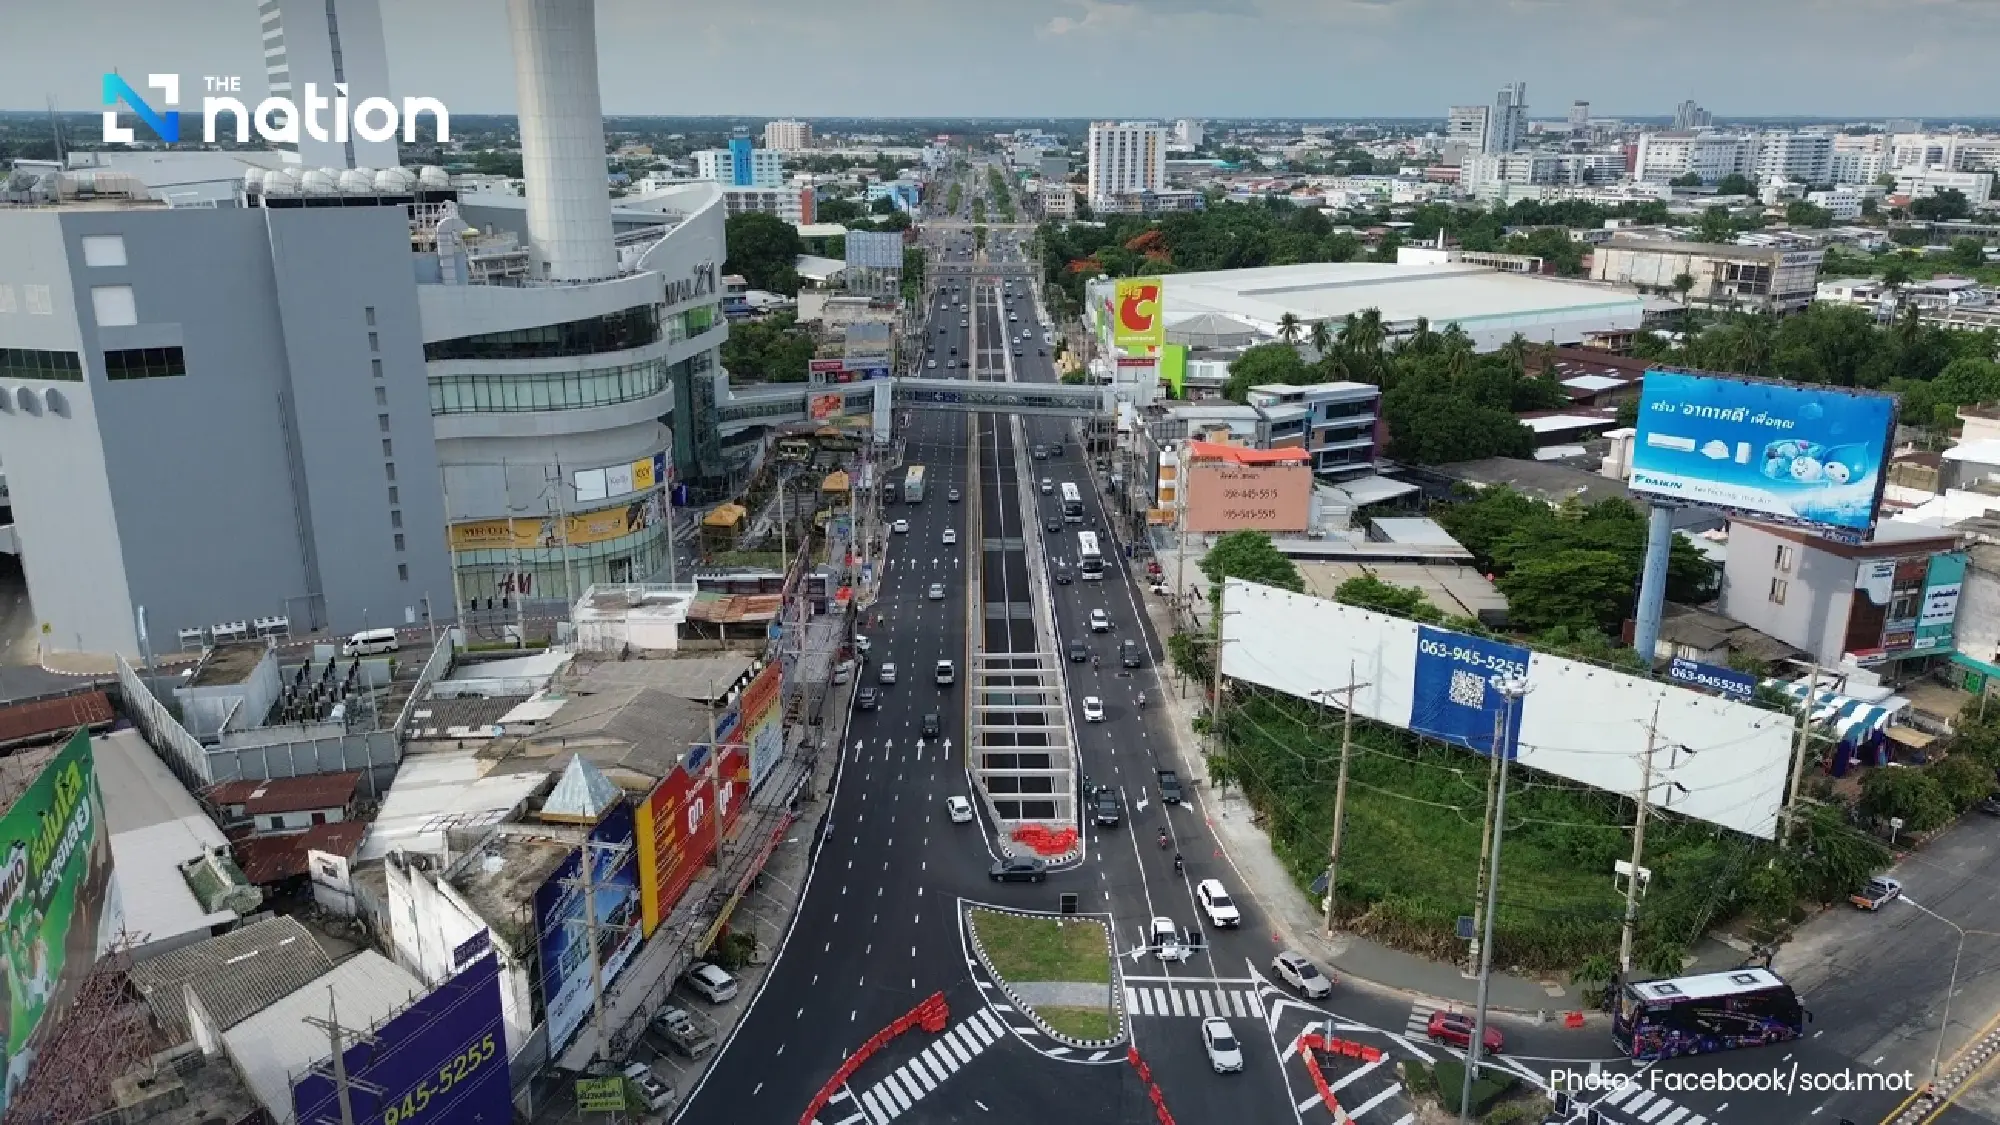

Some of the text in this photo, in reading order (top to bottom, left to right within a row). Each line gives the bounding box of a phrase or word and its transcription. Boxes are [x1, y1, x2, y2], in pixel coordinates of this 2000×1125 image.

[1121, 285, 1160, 332] C
[1420, 638, 1526, 679] 063-945-5255
[1671, 667, 1752, 696] 063-9455255
[384, 1032, 496, 1125] 945-5255
